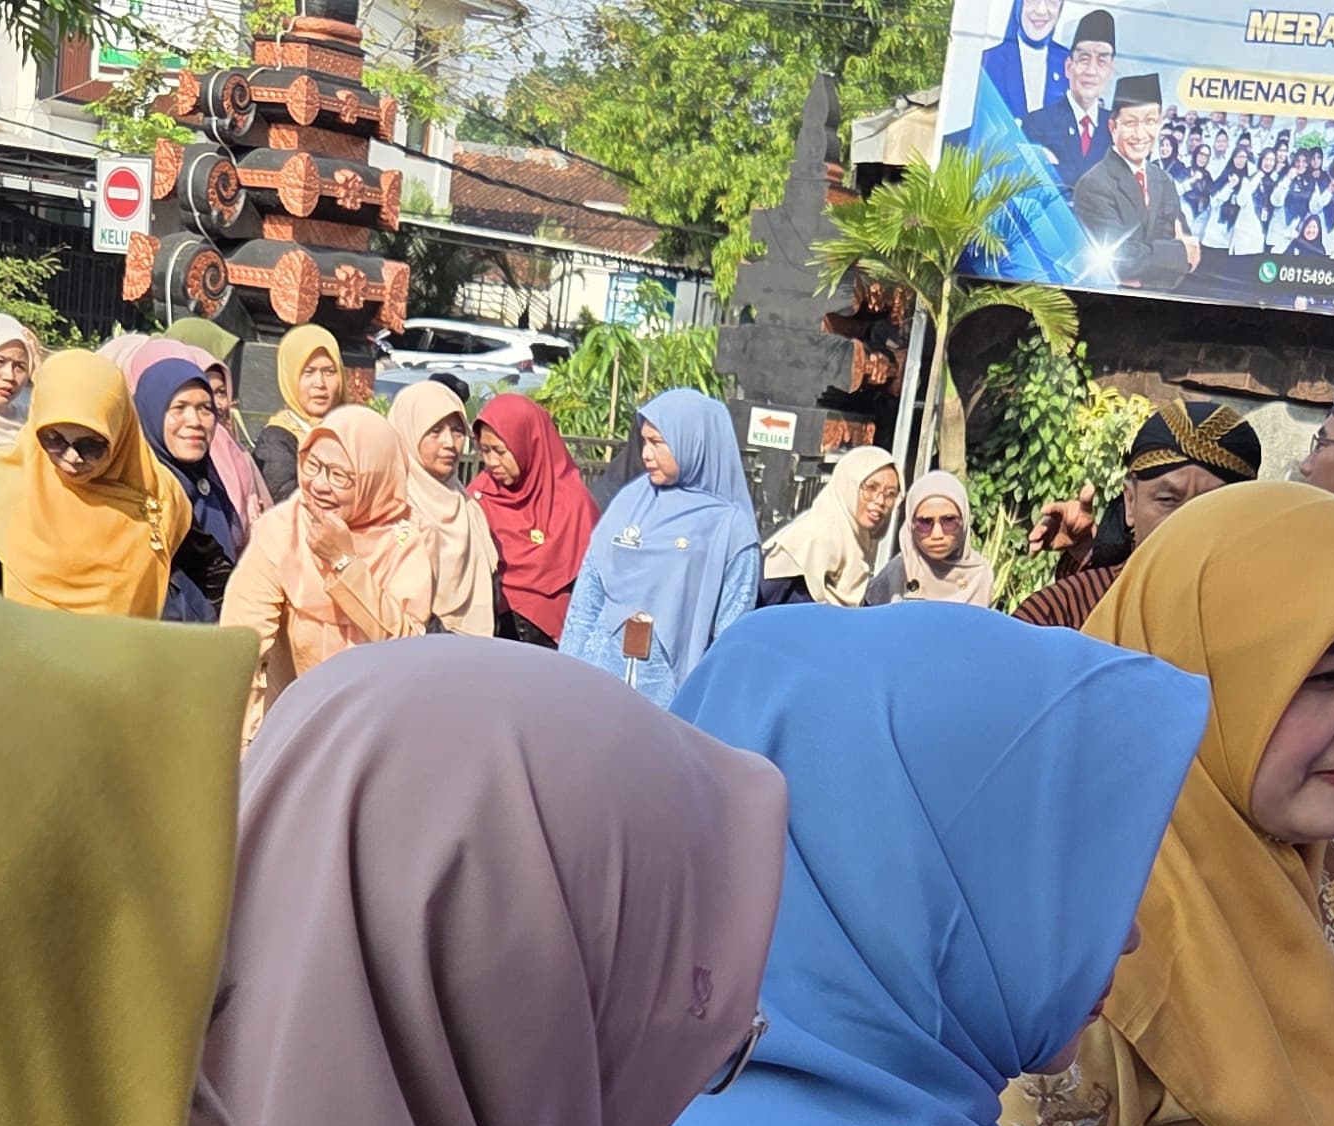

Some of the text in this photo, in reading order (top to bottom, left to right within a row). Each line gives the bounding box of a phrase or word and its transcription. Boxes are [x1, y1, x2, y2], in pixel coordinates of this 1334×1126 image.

[1189, 77, 1306, 104] KEMENAG
[100, 228, 128, 246] KELU
[752, 431, 789, 444] KELUAR
